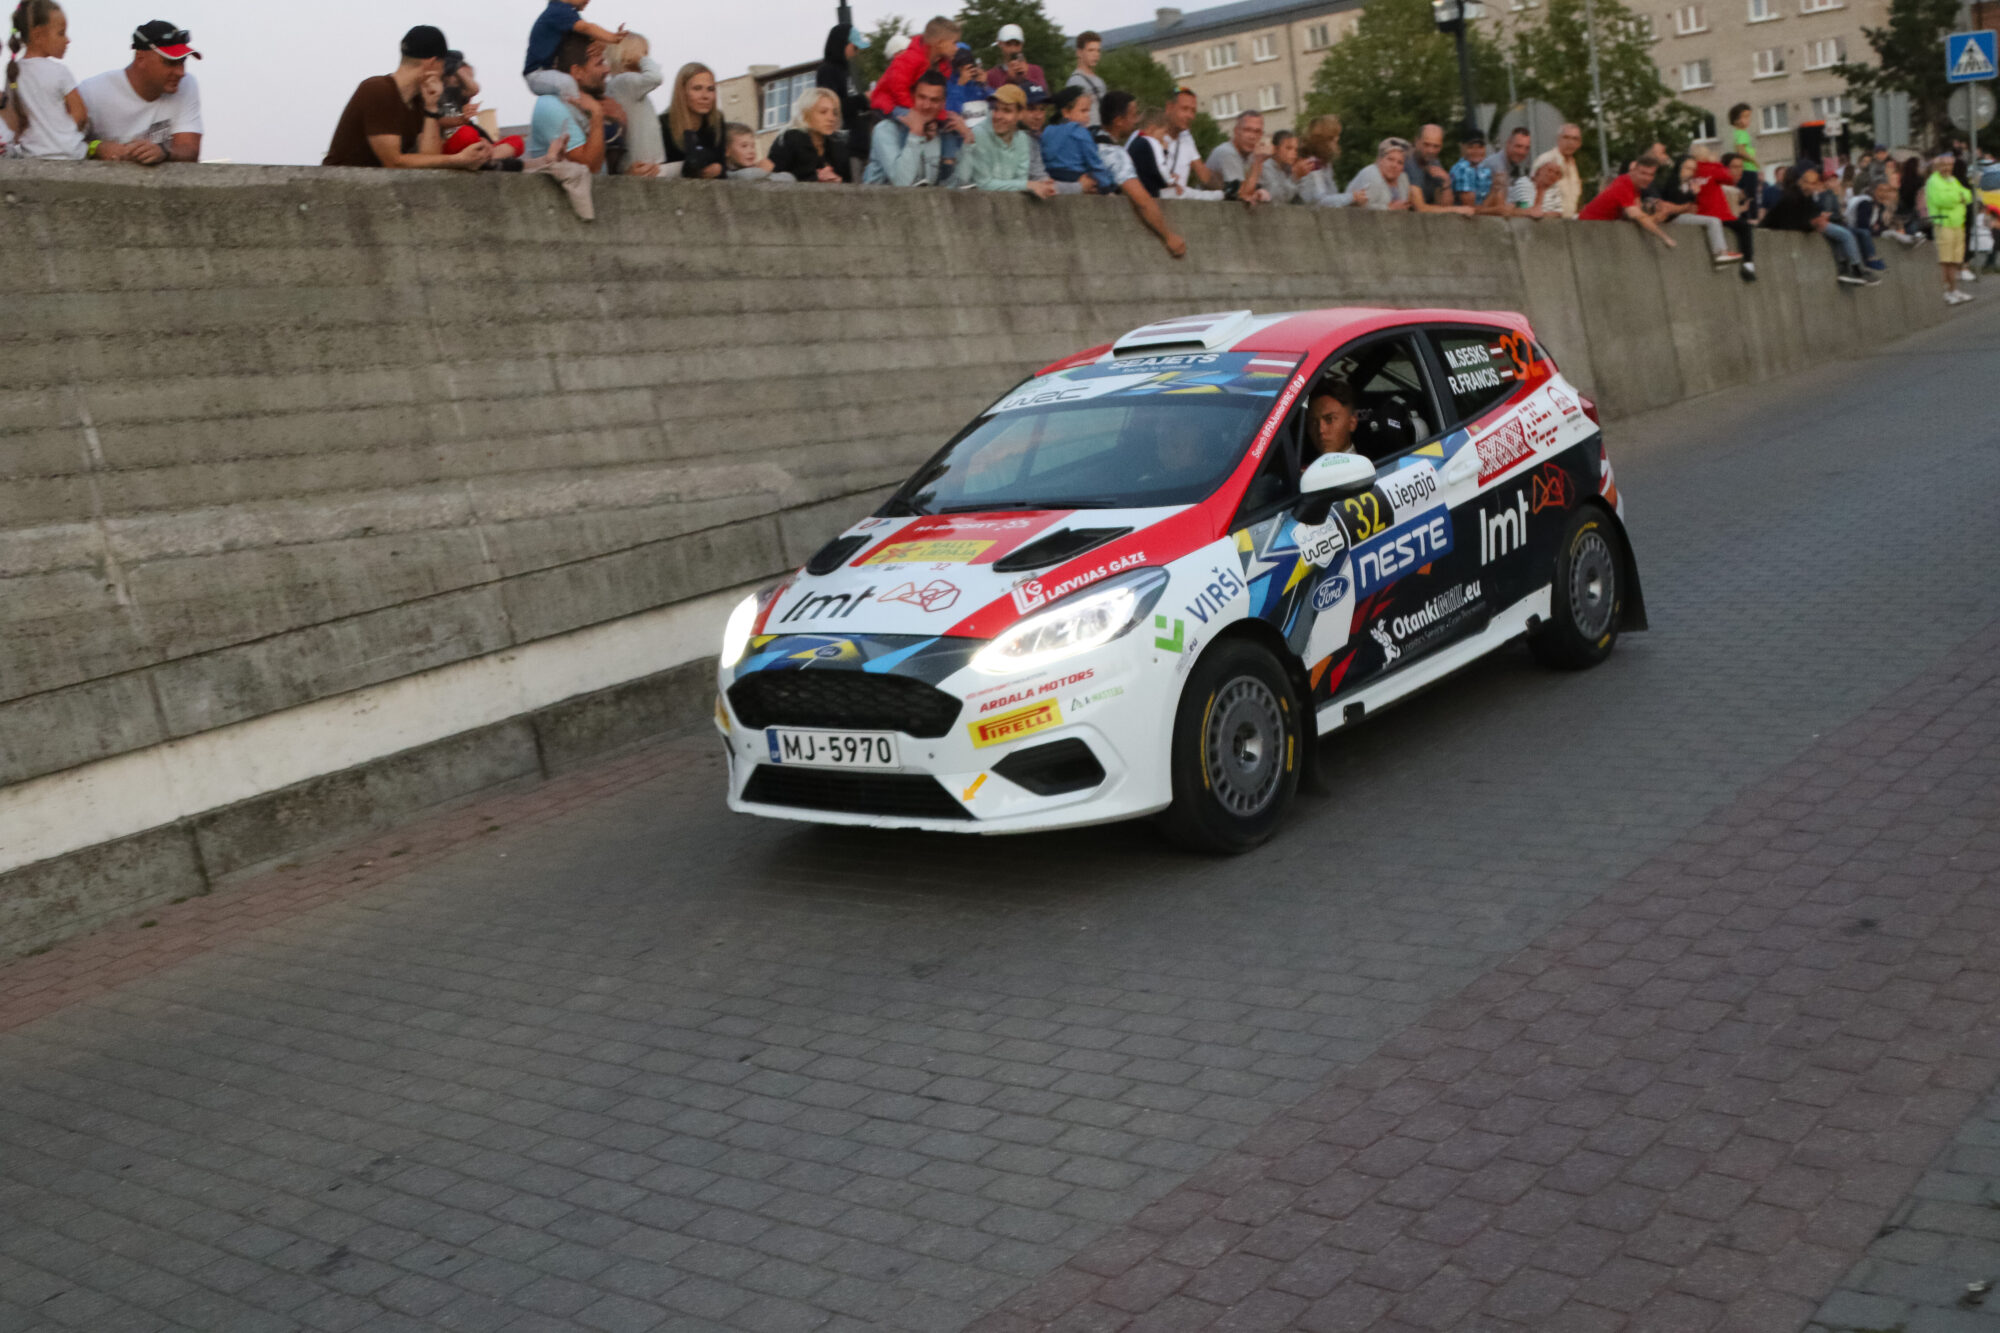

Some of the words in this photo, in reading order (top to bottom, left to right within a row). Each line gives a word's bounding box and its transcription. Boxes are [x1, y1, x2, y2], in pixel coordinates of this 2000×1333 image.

[1107, 353, 1220, 371] SEAJETS
[1445, 344, 1490, 369] M.SESKS
[1499, 330, 1545, 381] 32
[1448, 368, 1500, 395] R.FRANCIS
[1387, 472, 1437, 510] Liepāja
[1345, 492, 1386, 540] 32
[1479, 489, 1529, 567] lmt
[1303, 533, 1343, 562] WRC
[1359, 516, 1448, 589] NESTE
[1046, 566, 1107, 600] LATVIJAS
[1185, 565, 1246, 624] VIRŠI
[1317, 580, 1344, 608] Ford
[1038, 668, 1095, 695] MOTORS
[978, 705, 1054, 741] PIRELLI
[783, 734, 892, 764] MJ-5970
